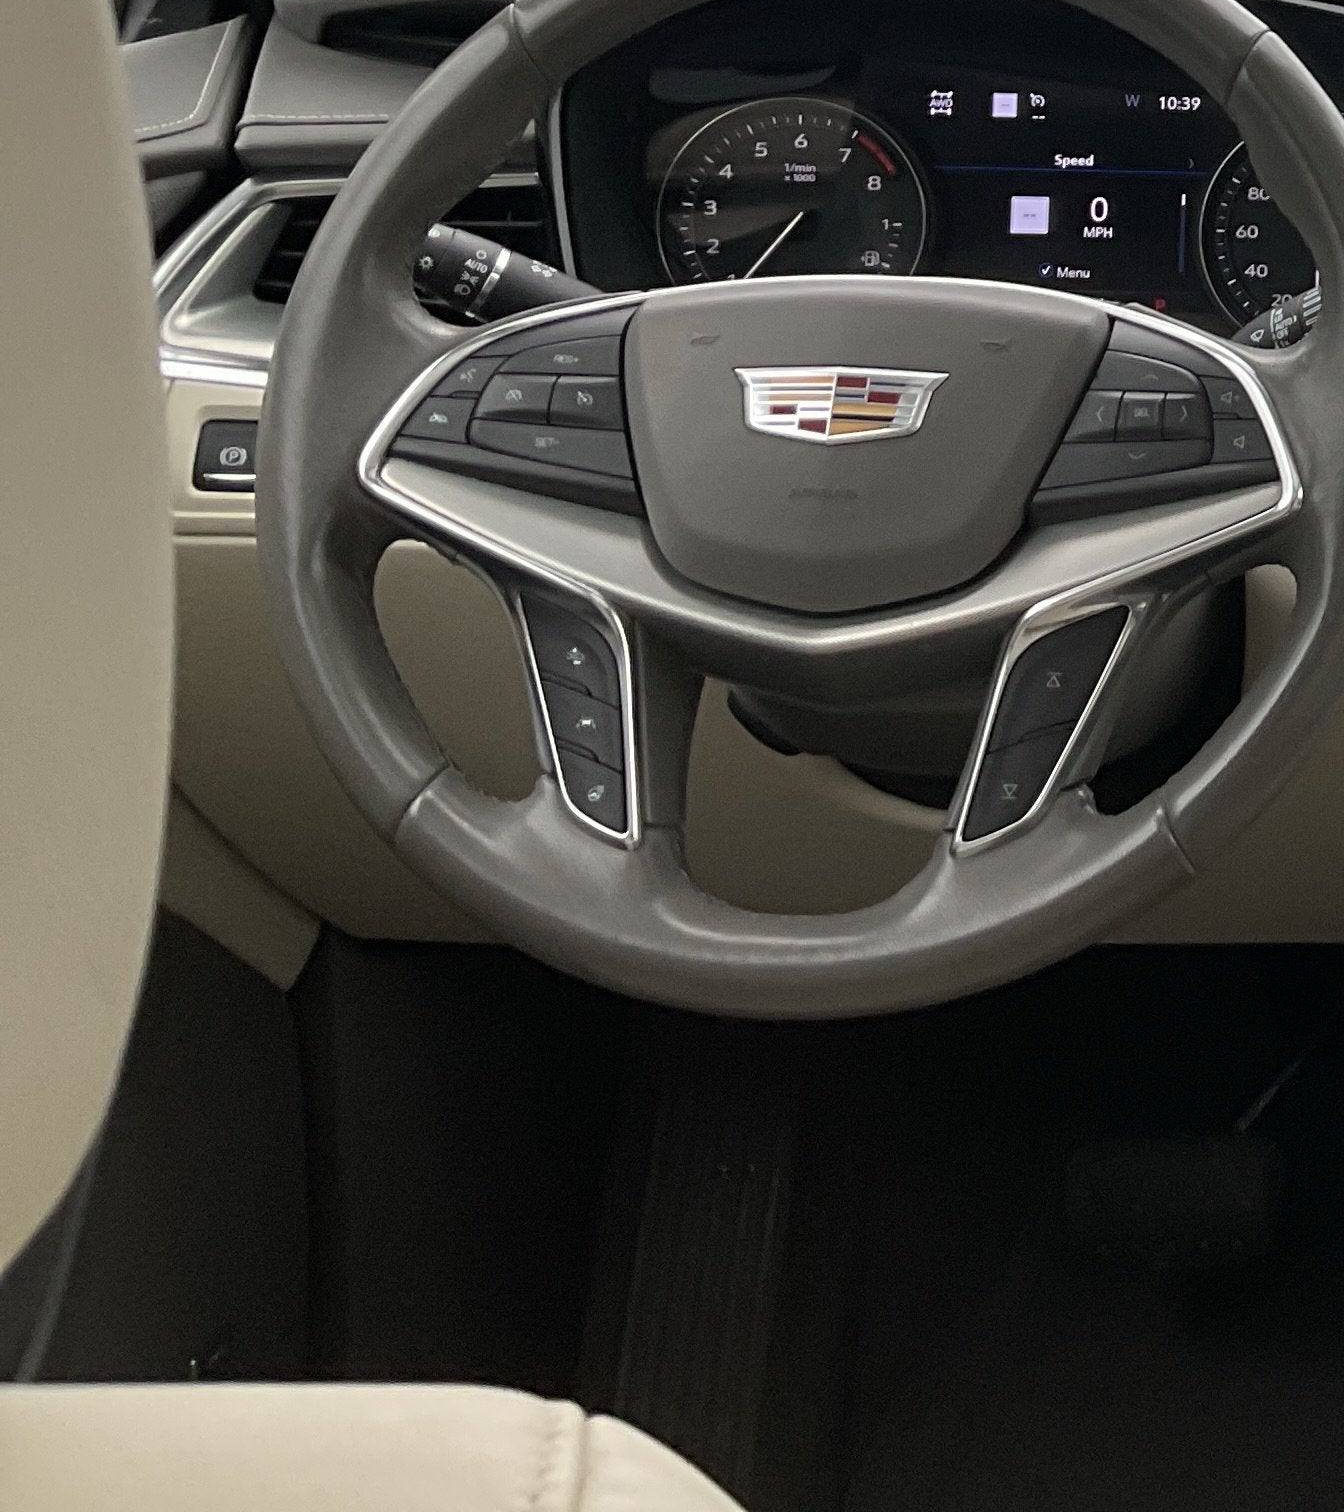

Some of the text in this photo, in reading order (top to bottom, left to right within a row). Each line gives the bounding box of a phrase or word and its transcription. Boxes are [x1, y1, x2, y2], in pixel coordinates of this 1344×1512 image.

[1125, 93, 1141, 108] W
[1158, 96, 1202, 111] 10:39
[754, 141, 769, 157] 5
[793, 133, 809, 149] 6
[838, 147, 852, 164] 7
[1053, 153, 1095, 169] Speed
[718, 163, 734, 180] 4
[784, 162, 817, 174] 1/min
[867, 175, 882, 191] 8
[704, 199, 718, 216] 3
[1089, 196, 1110, 223] 0
[1083, 226, 1113, 239] MPH
[1235, 224, 1259, 239] 60
[706, 238, 720, 254] 2
[464, 259, 488, 275] AUTO
[1056, 266, 1091, 280] Menu
[1244, 263, 1269, 278] 40
[1275, 317, 1293, 332] AUTO
[1276, 327, 1289, 340] OFF
